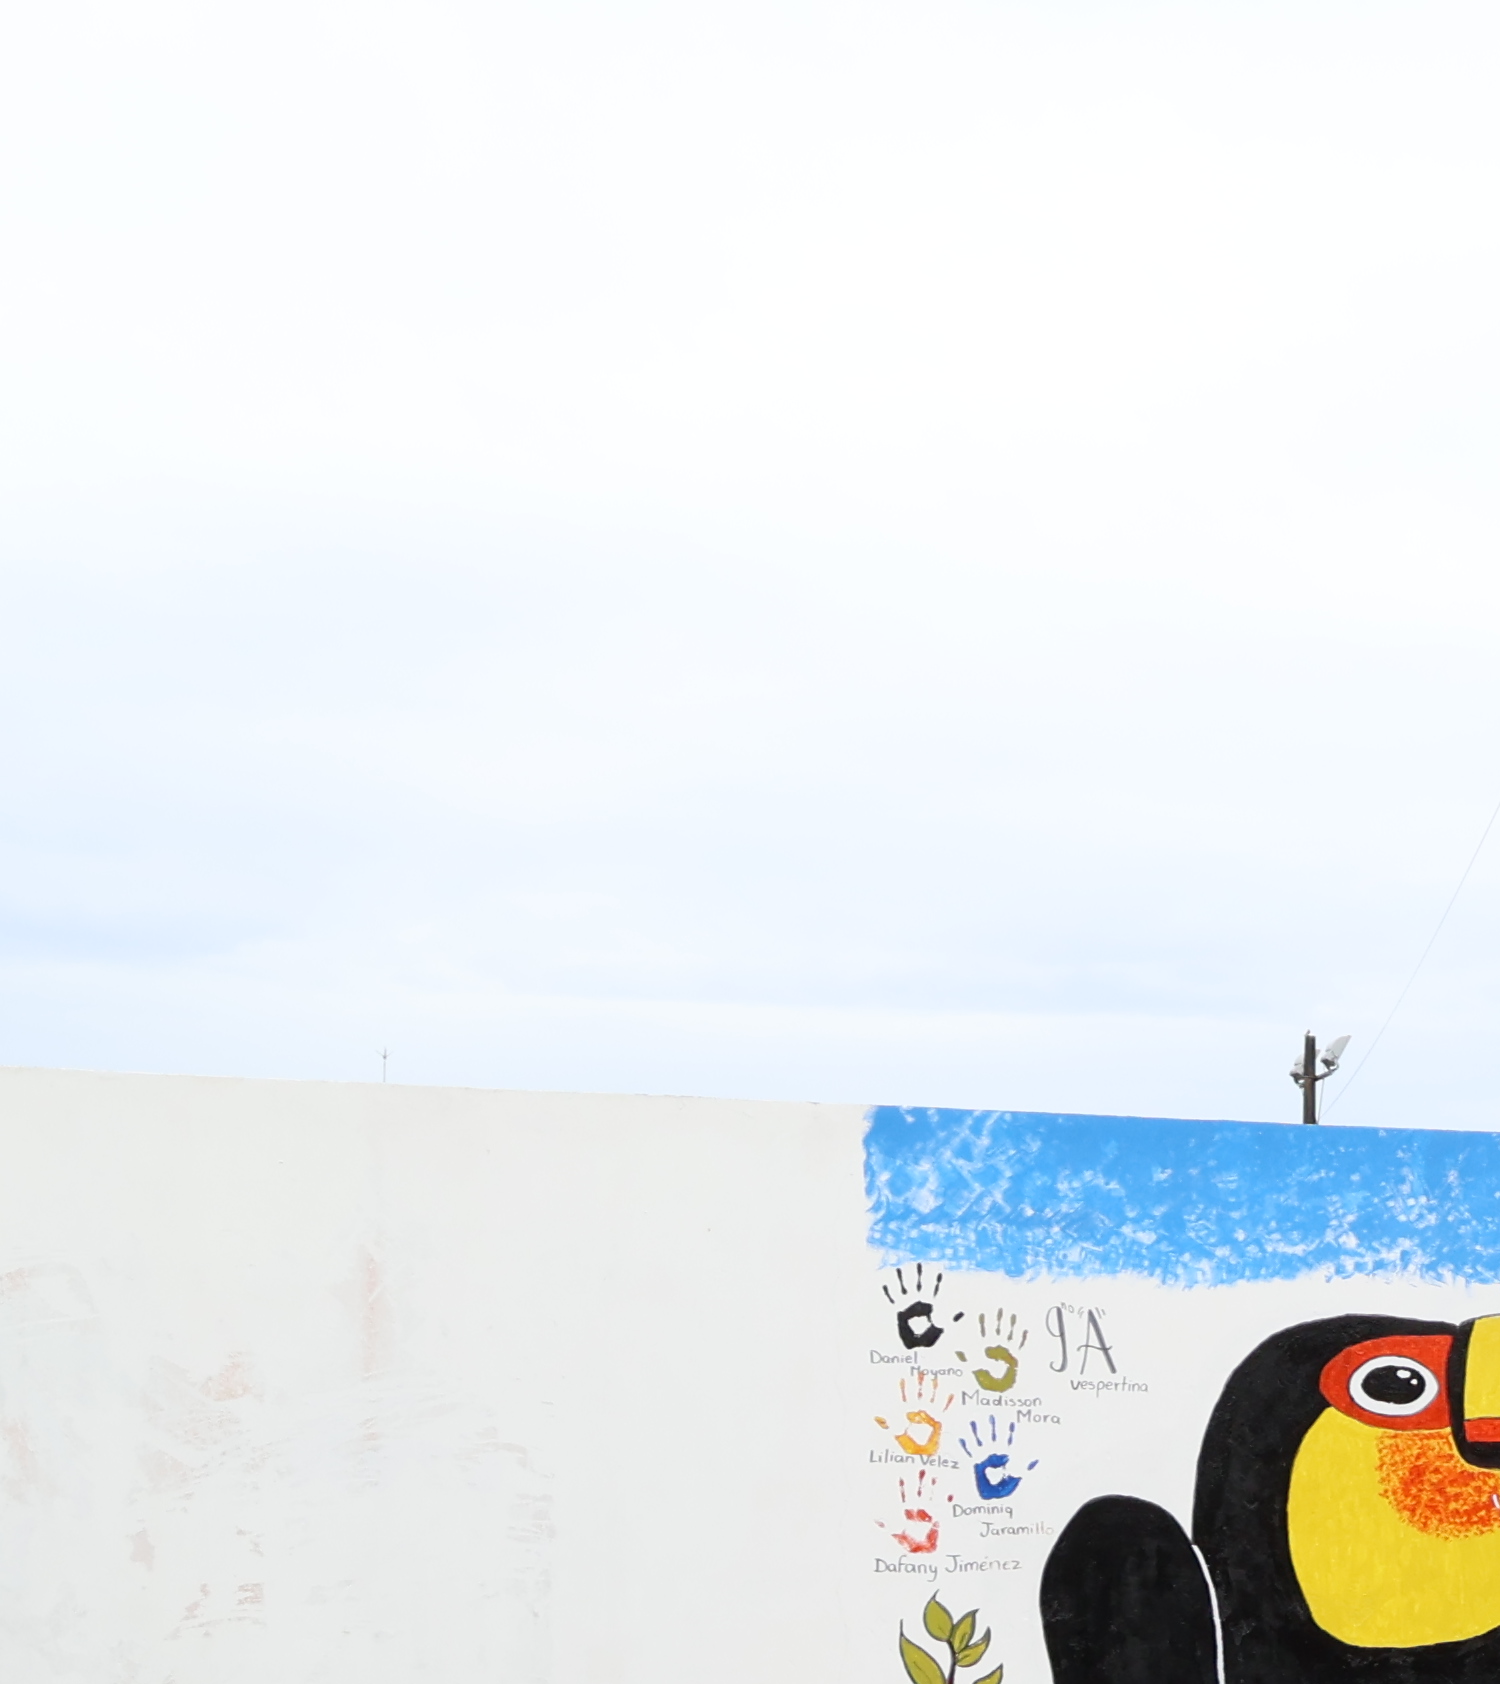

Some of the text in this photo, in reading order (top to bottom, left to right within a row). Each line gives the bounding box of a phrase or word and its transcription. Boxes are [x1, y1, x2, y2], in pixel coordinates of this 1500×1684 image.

[870, 1350, 918, 1365] Daniel
[910, 1365, 964, 1379] Moyano
[1069, 1376, 1149, 1398] vespertina
[961, 1390, 1043, 1408] Madisson
[1016, 1409, 1062, 1425] Mora
[869, 1449, 960, 1470] Lilian Velez
[952, 1503, 1013, 1519] Dominiq
[979, 1519, 1055, 1538] Jaramillo
[873, 1554, 1023, 1582] Dafany Jiménez
